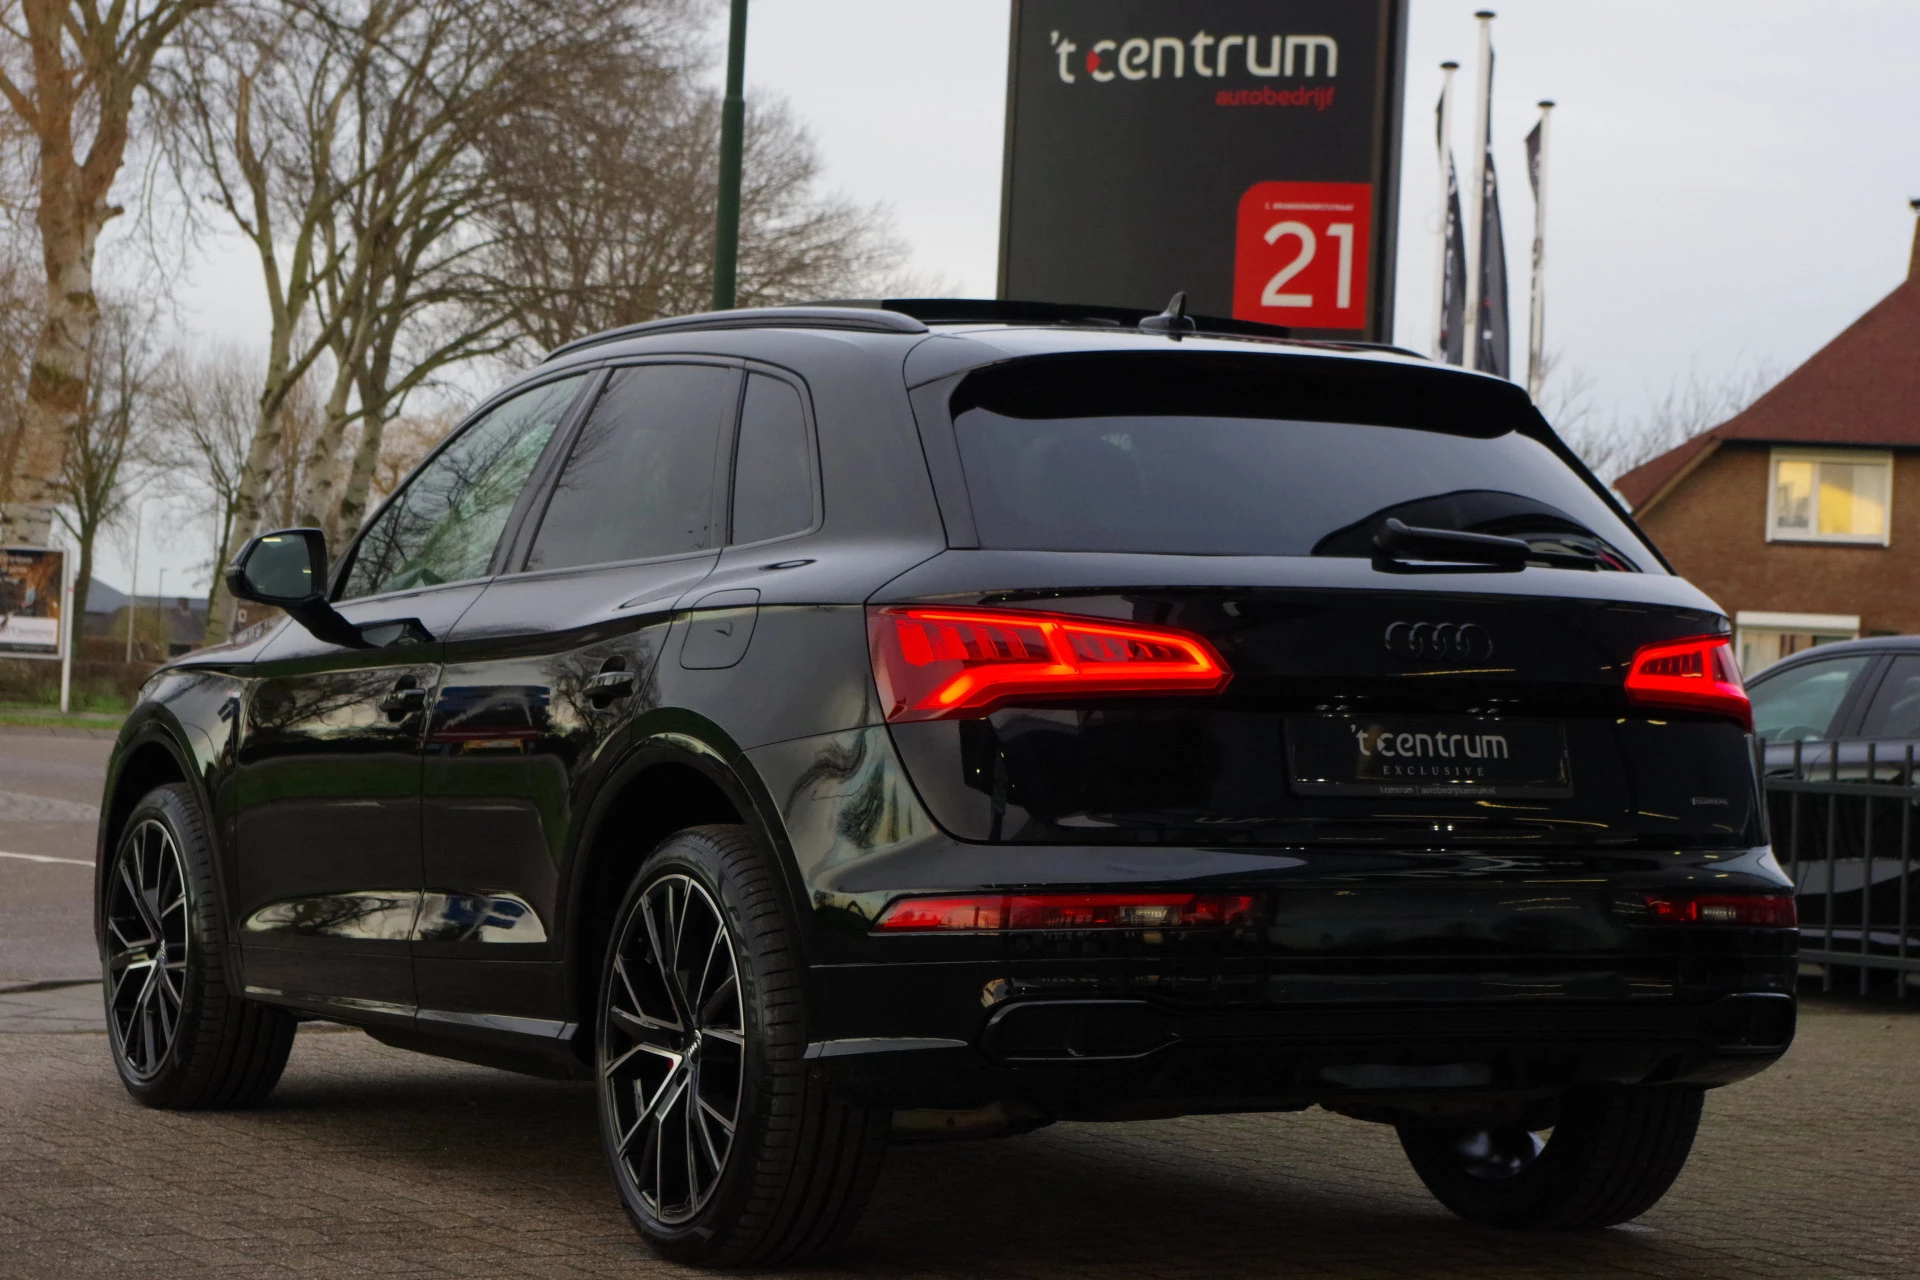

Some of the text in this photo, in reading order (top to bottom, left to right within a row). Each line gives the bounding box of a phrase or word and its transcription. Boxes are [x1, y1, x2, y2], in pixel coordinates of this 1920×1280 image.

[1086, 31, 1338, 82] centrum
[1215, 86, 1336, 111] autobedrijf
[1261, 220, 1354, 309] 21
[1376, 730, 1508, 759] centrum
[1383, 764, 1485, 777] EXCLUSIVE
